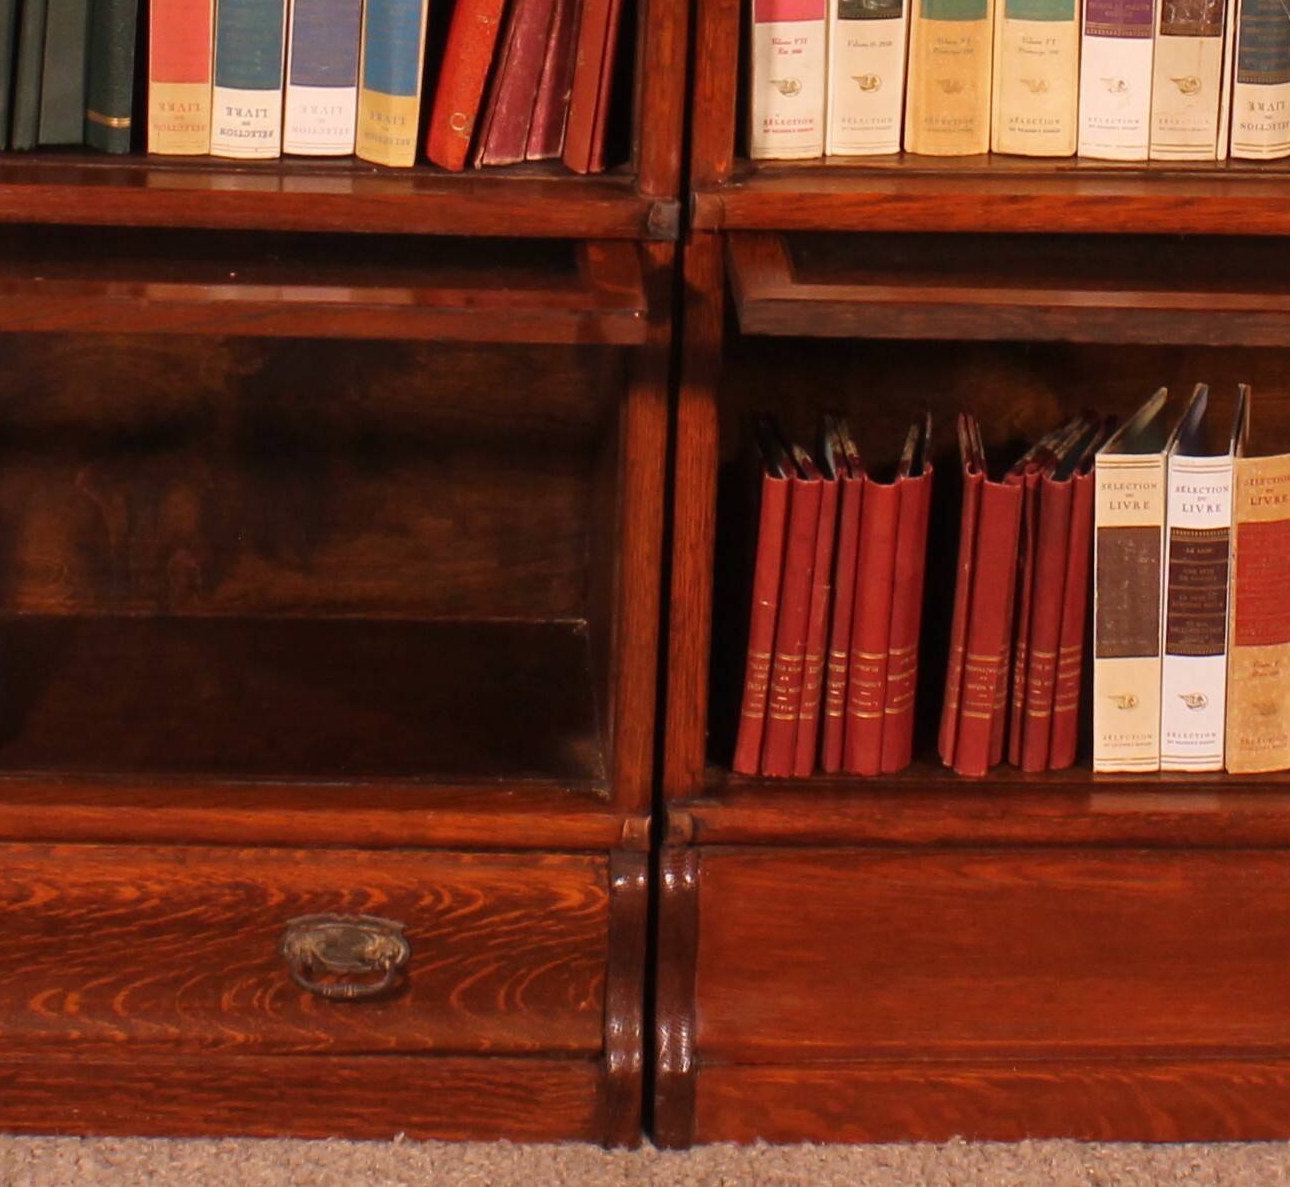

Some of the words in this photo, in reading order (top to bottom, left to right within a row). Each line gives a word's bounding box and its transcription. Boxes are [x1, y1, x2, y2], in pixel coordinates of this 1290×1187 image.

[225, 106, 269, 119] LIVRE
[1109, 500, 1150, 511] LIVRE
[1249, 494, 1289, 507] LIVRE
[1182, 504, 1222, 514] LIVRE
